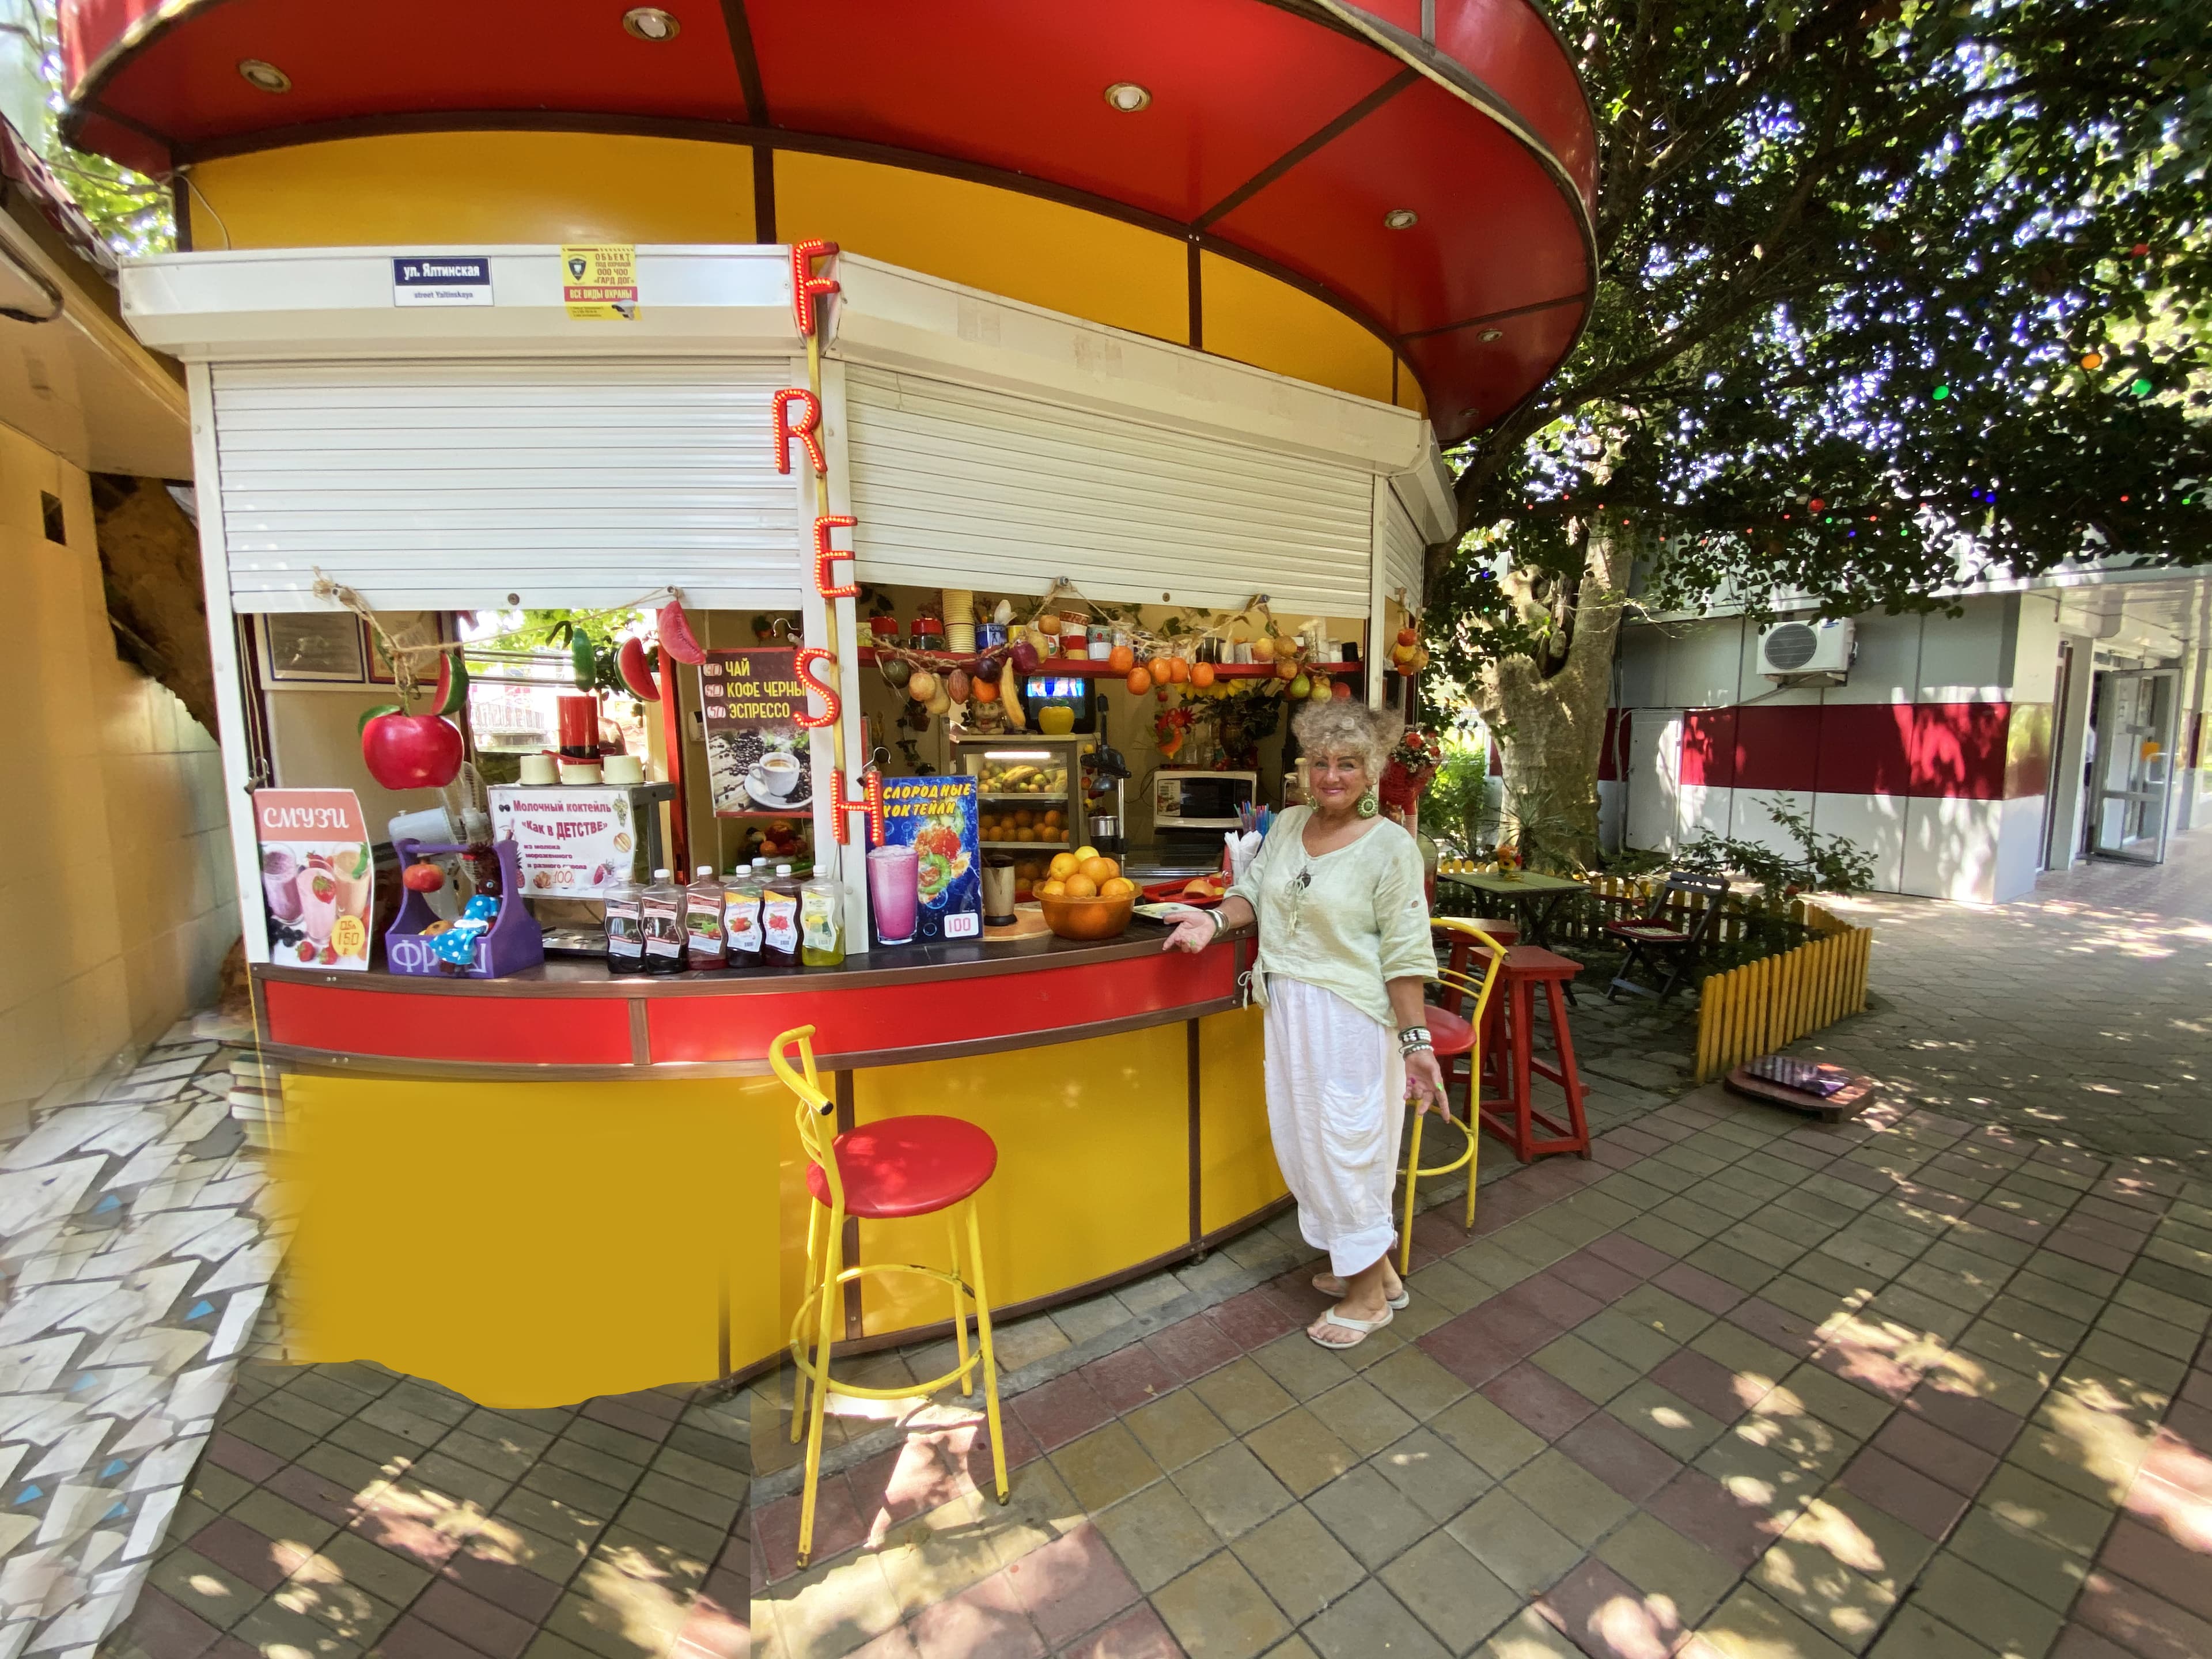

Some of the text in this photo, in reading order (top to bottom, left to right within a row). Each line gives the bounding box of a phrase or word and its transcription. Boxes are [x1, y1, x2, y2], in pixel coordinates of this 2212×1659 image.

[404, 263, 479, 281] ул. Ялтинская
[436, 291, 473, 300] Yaltinskaya
[570, 289, 632, 299] ВСЕ ВИДЫ ОХРАНЫ
[725, 657, 750, 676] ЧАЙ
[727, 681, 808, 698] КОФЕ ЧЕРНЫ
[729, 702, 790, 719] ЭСПРЕССО
[864, 783, 972, 801] СЛОРОДНЫЕ
[513, 799, 611, 813] Молочный коктейль
[264, 808, 350, 828] СМУЗИ
[522, 820, 544, 834] «Как
[556, 821, 608, 840] ДЕТСТВЕ»
[949, 917, 971, 933] 100
[339, 932, 359, 945] 150
